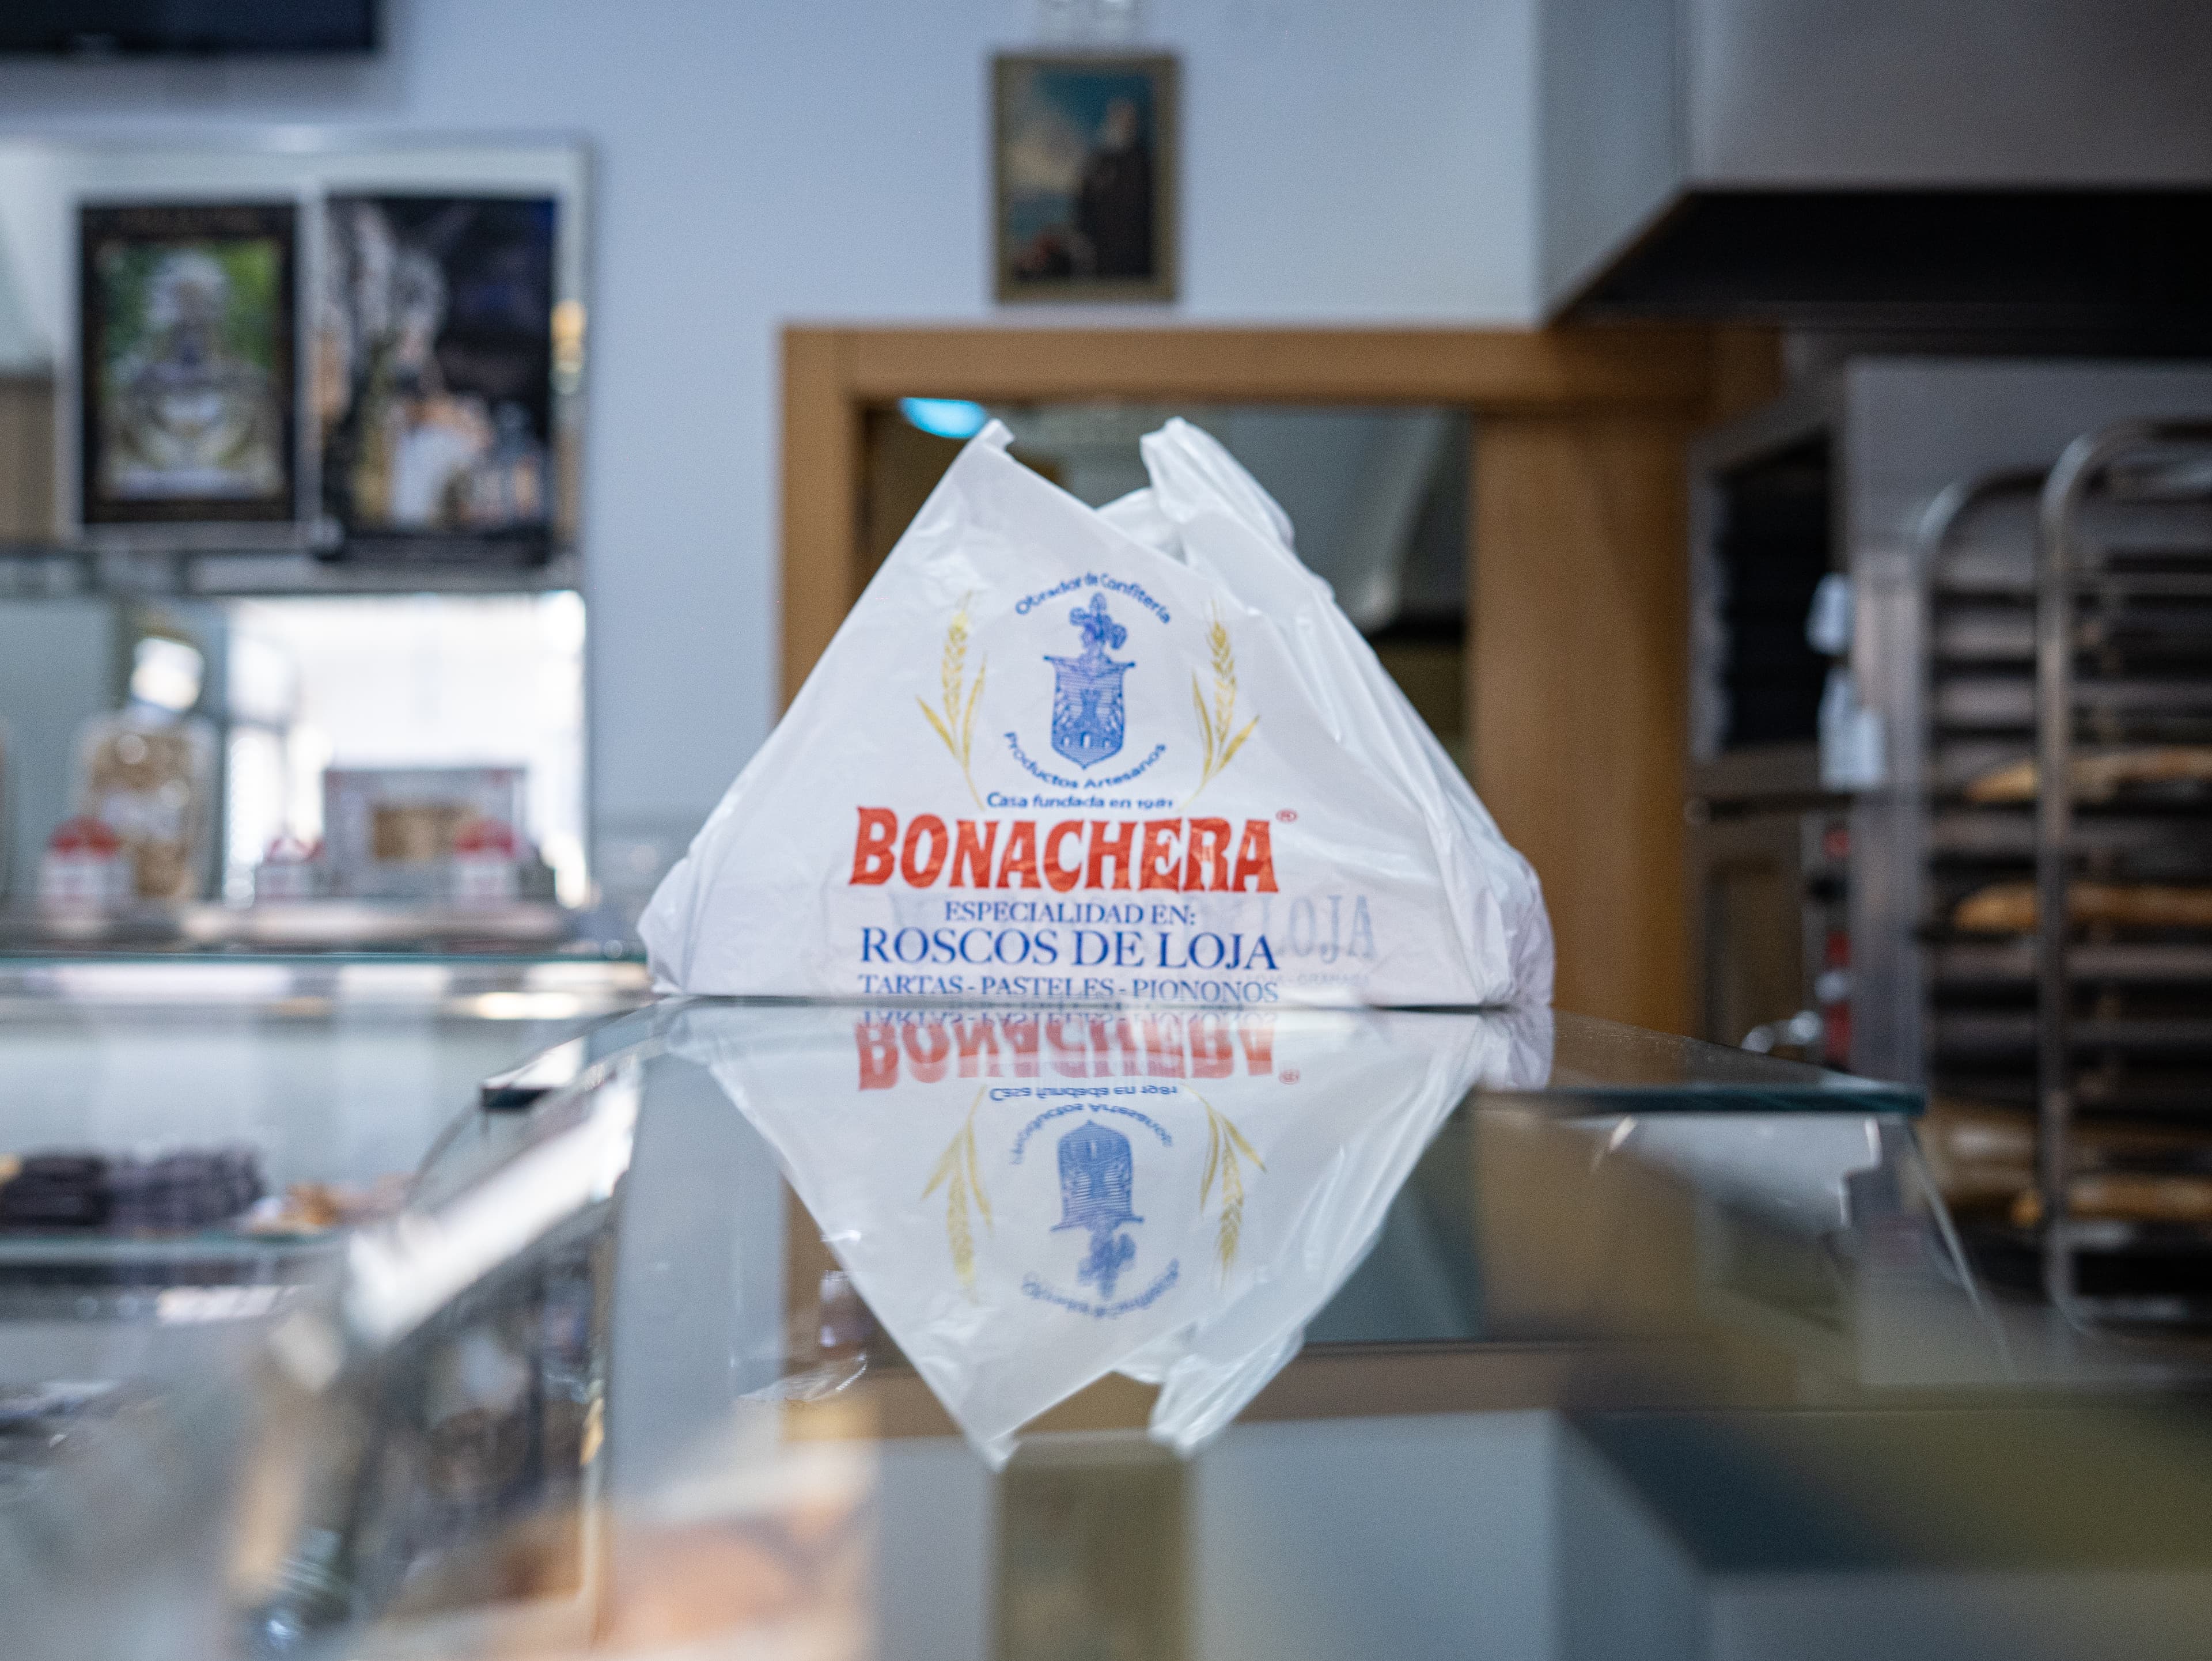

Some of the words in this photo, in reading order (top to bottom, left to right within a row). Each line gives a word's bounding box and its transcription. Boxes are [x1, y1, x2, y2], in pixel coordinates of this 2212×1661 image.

[1014, 576, 1081, 616] Obrador
[1003, 731, 1078, 788] Productos
[1083, 744, 1166, 788] Artesanos
[987, 791, 1028, 807] Casa
[1033, 793, 1105, 807] fundada
[1109, 799, 1131, 807] en
[849, 805, 1279, 893] BONACHERA
[945, 900, 1145, 924] ESPECIALIDAD
[1152, 904, 1196, 926] EN:
[861, 926, 1059, 966] ROSCOS
[1071, 930, 1145, 967] DE
[1156, 931, 1280, 970] LOJA
[858, 973, 964, 995] TARTAS
[980, 976, 1115, 997] PASTELES
[1132, 978, 1279, 1003] PIONONOS
